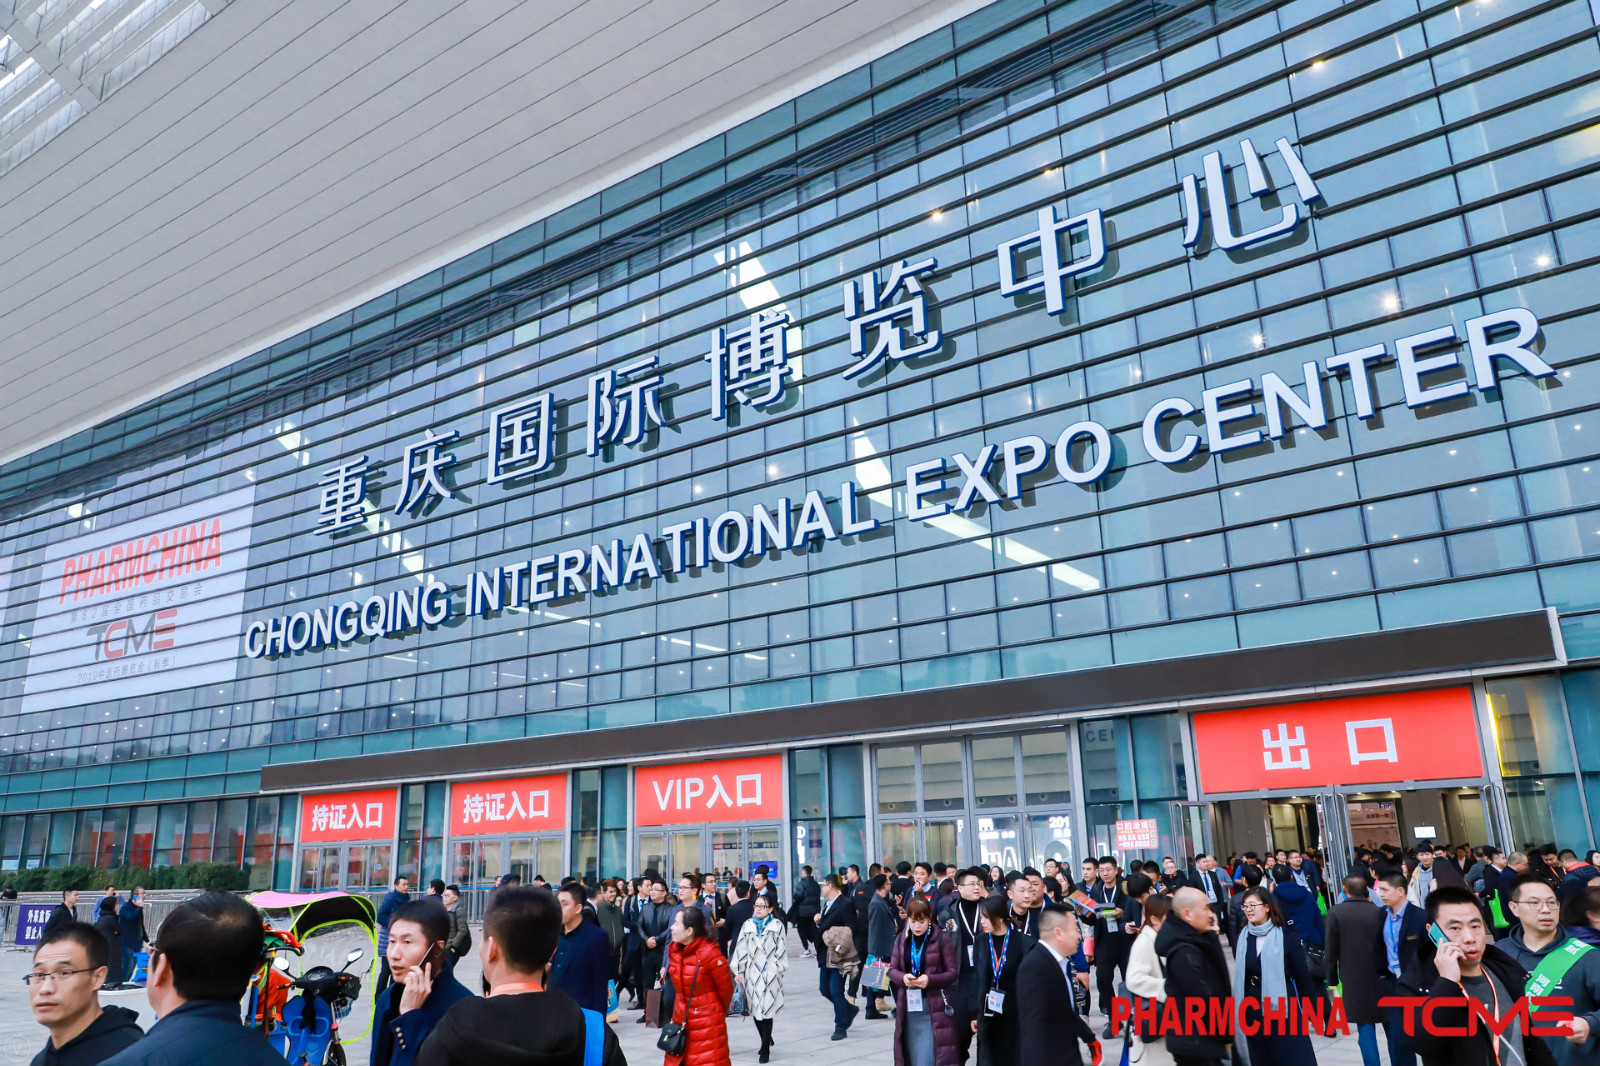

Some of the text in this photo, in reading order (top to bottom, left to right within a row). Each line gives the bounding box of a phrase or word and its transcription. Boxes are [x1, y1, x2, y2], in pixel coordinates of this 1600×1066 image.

[313, 136, 1321, 536] 重庆国际博览中心
[244, 306, 1557, 660] CHONGQING INTERNATIONAL EXPO CENTER
[59, 517, 221, 605] PHARMCHINA
[86, 608, 178, 661] TCME
[1262, 718, 1398, 770] 出口
[312, 803, 383, 831] 持证入口
[463, 790, 549, 823] 持证入口
[652, 773, 762, 811] VIP入口
